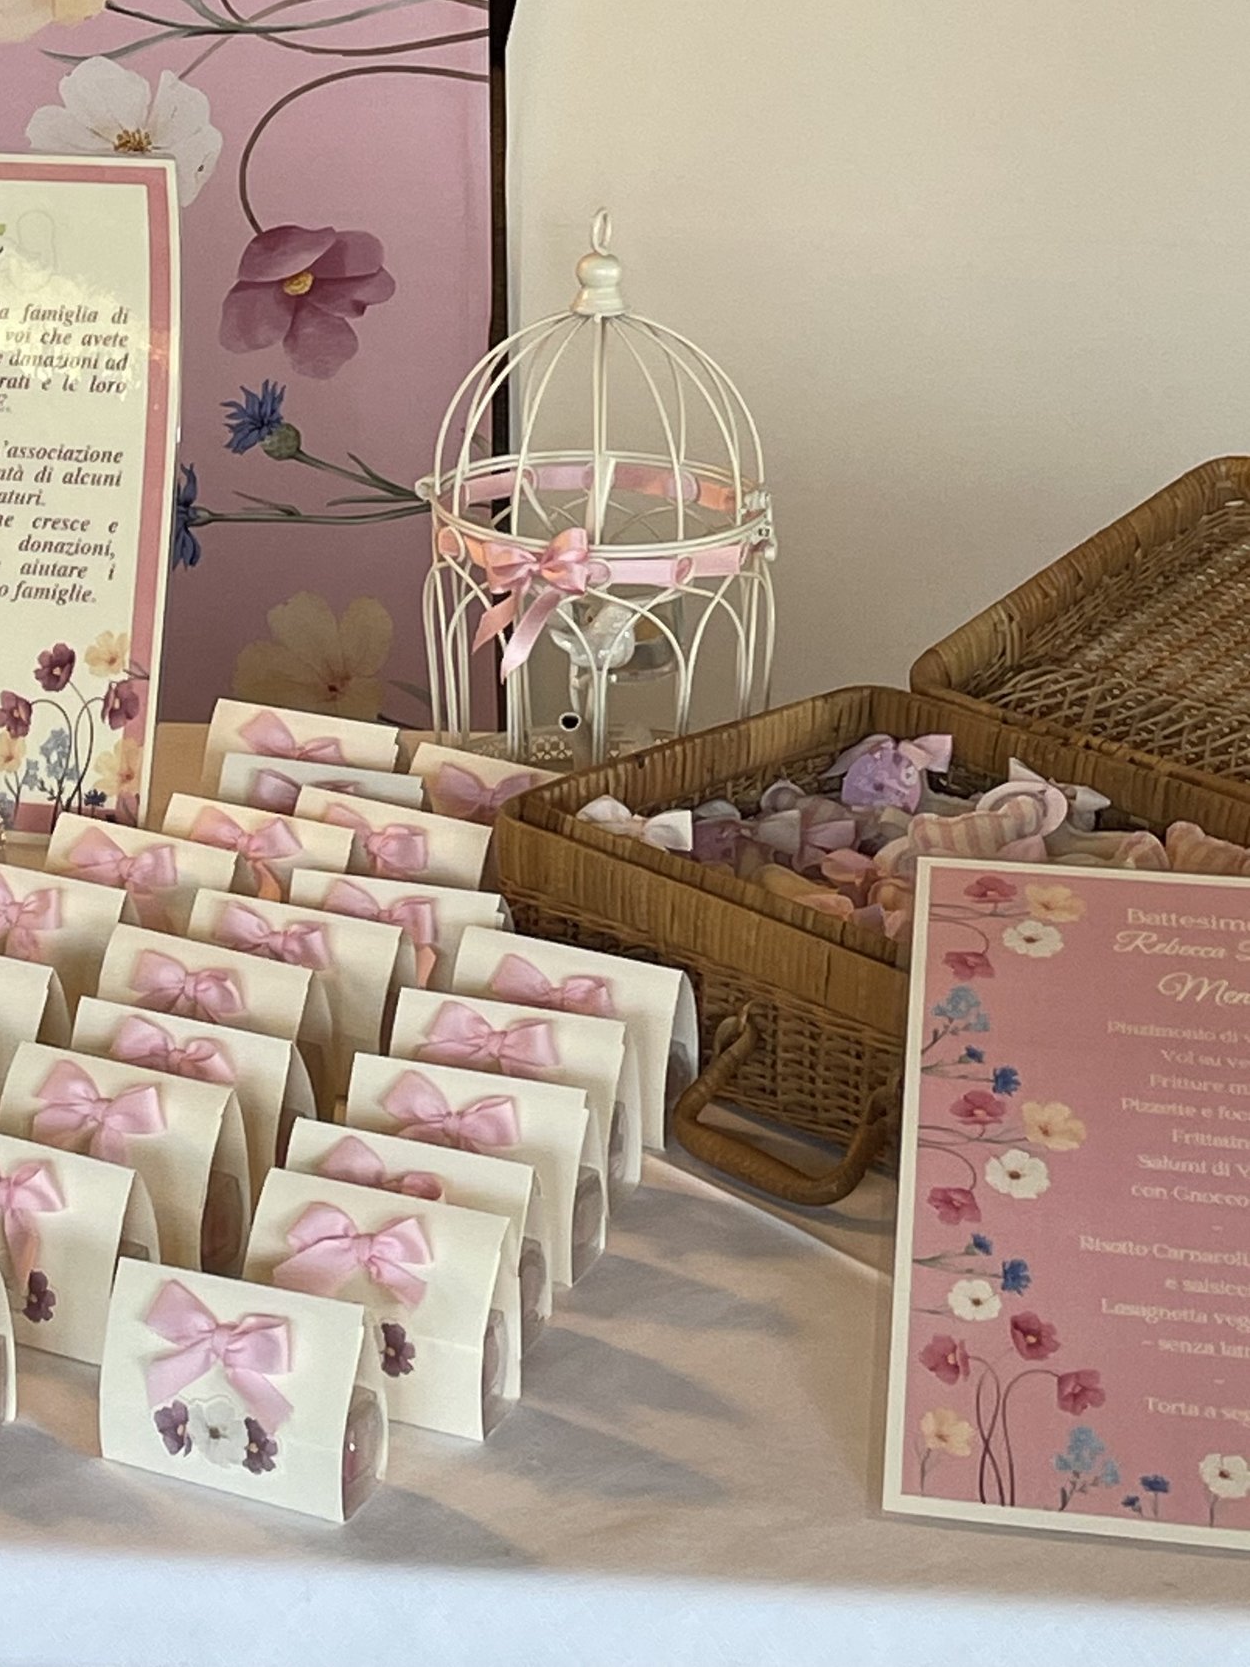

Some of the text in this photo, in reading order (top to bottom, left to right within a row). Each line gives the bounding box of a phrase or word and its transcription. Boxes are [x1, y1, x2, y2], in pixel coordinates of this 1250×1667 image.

[22, 303, 98, 327] famiglia
[112, 307, 129, 325] di
[6, 329, 31, 343] voi
[40, 329, 72, 345] che
[81, 334, 129, 348] avete
[9, 350, 98, 369] donazioni
[105, 353, 129, 371] ad
[41, 379, 50, 391] e
[63, 375, 77, 392] le
[89, 375, 126, 394] loro
[34, 464, 52, 483] di
[62, 466, 122, 487] alcuni
[32, 515, 91, 532] cresce
[108, 521, 119, 533] e
[18, 534, 116, 560] donazioni,
[20, 561, 88, 579] aiutare
[107, 563, 115, 580] i
[11, 580, 97, 605] famiglie.
[1113, 931, 1226, 959] Rebecca
[1220, 1028, 1238, 1043] di
[1161, 1049, 1193, 1065] Vol
[1150, 1074, 1224, 1093] Fritture
[1122, 1097, 1196, 1117] Pizzette
[1201, 1108, 1212, 1119] e
[1138, 1153, 1206, 1174] Salumi
[1212, 1160, 1230, 1177] di
[1131, 1183, 1167, 1200] con
[1079, 1235, 1148, 1256] Risotto
[1165, 1278, 1177, 1289] e
[1101, 1297, 1207, 1324] Lasagnetta
[1158, 1338, 1214, 1354] senza
[1146, 1397, 1199, 1416] Torta
[1204, 1406, 1216, 1418] a
